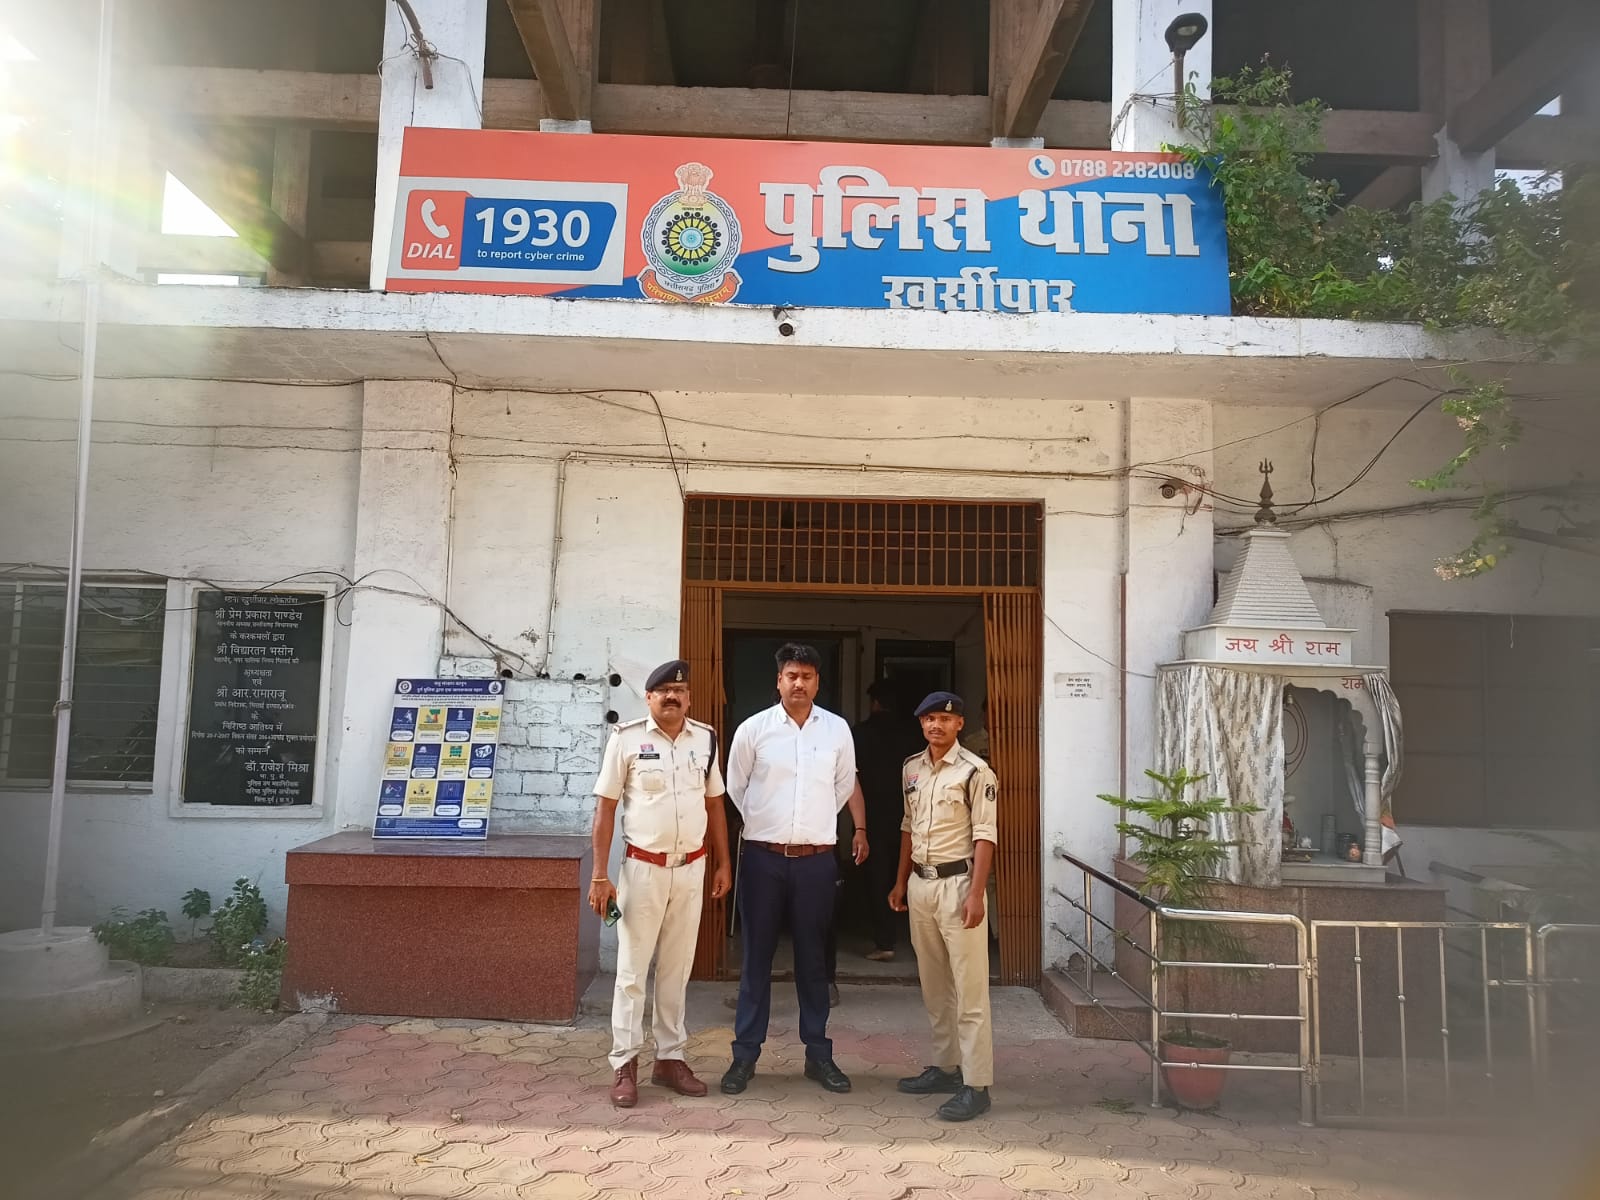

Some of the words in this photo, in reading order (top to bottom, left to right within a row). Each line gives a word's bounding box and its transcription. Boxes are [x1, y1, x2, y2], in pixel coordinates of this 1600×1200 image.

[1060, 159, 1107, 177] 0788
[1112, 161, 1195, 180] 2282008
[760, 166, 990, 273] पुलिस
[1019, 189, 1200, 256] थाना
[475, 207, 590, 248] 1930
[407, 242, 456, 259] DIAL
[477, 249, 488, 258] to
[490, 250, 522, 260] report
[524, 250, 554, 262] cyber
[556, 252, 585, 261] crime
[215, 607, 225, 619] श्री
[228, 607, 242, 619] प्रेम
[245, 610, 271, 620] प्रकाश
[274, 608, 303, 620] पाण्डेय
[217, 643, 227, 655] श्री
[1225, 637, 1259, 653] जय
[1268, 633, 1294, 655] श्री
[1305, 641, 1341, 656] राम
[216, 685, 228, 699] श्री
[288, 761, 310, 772] मिश्रा
